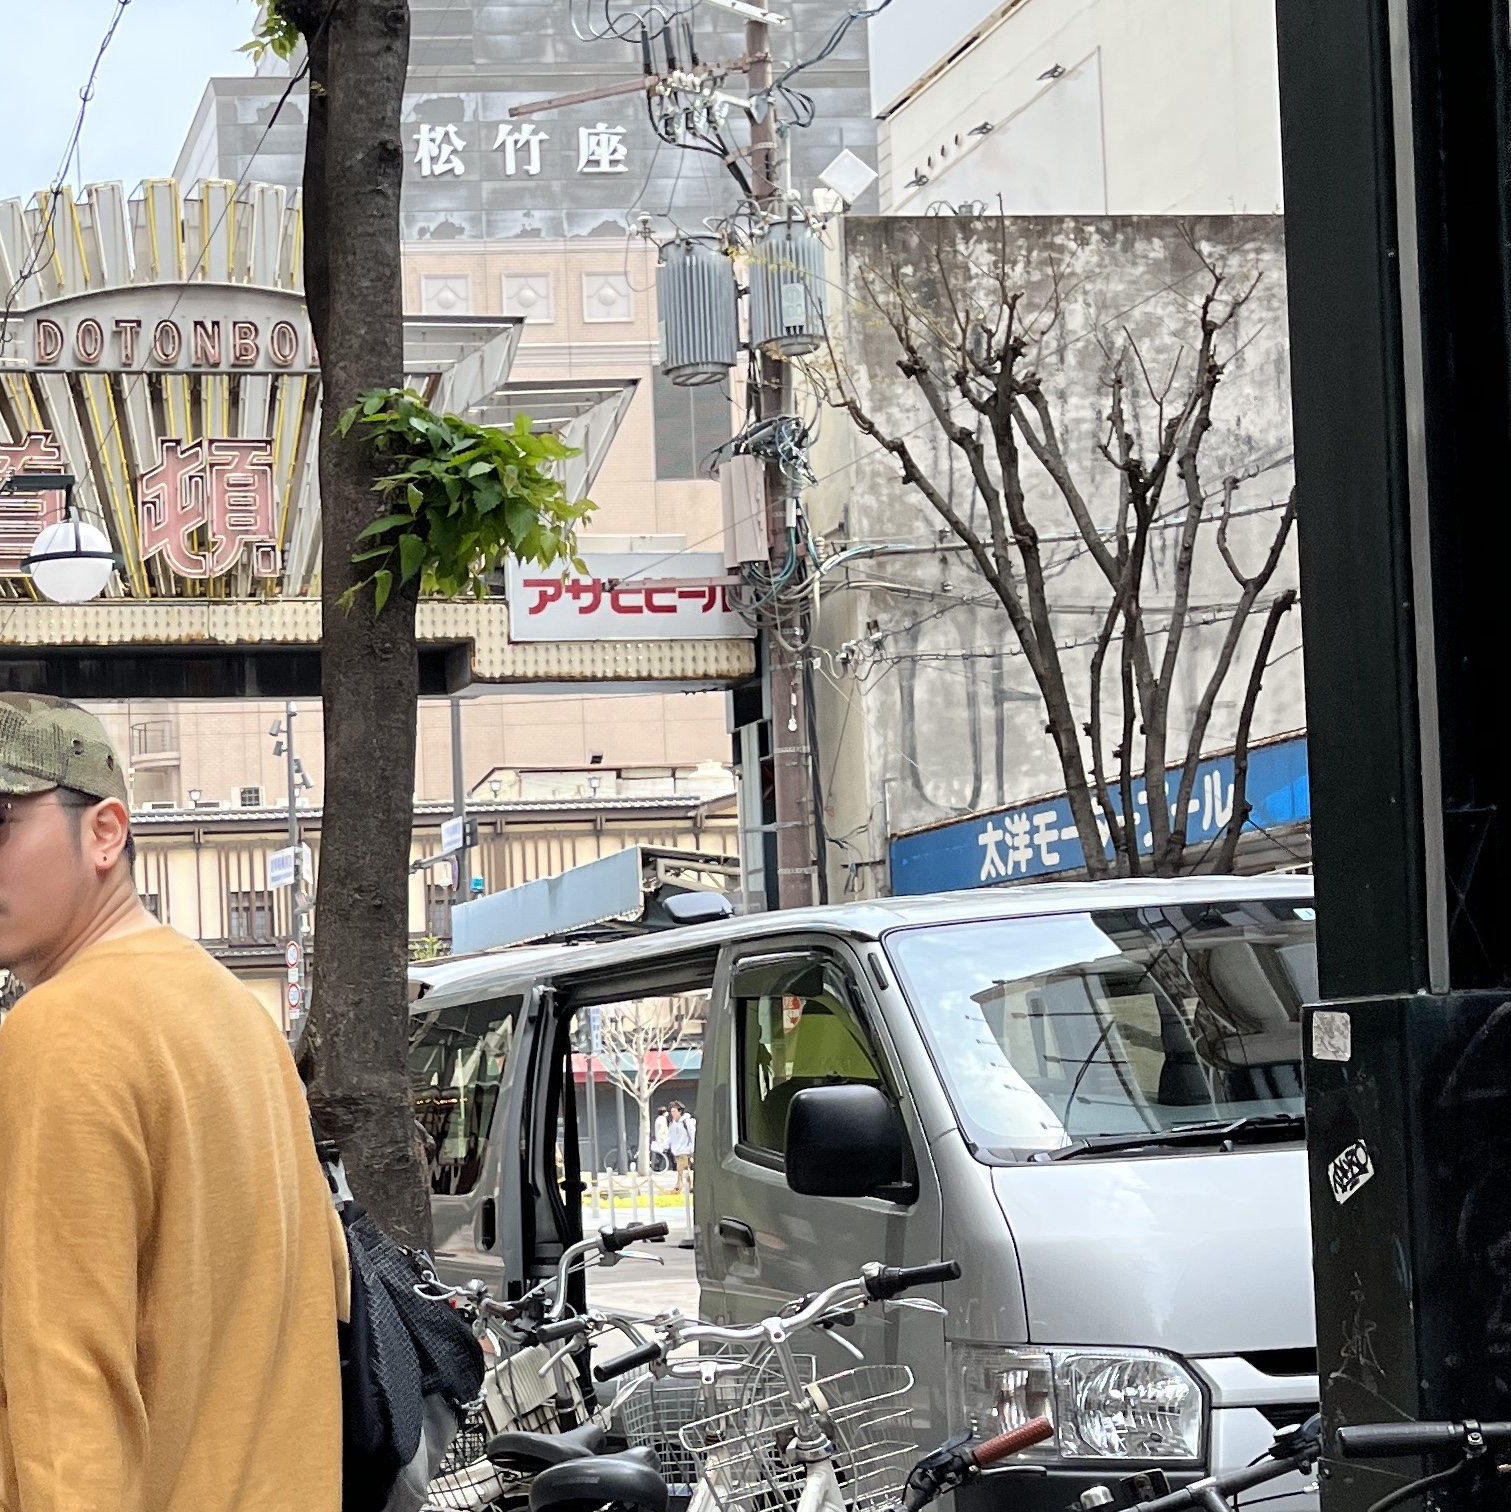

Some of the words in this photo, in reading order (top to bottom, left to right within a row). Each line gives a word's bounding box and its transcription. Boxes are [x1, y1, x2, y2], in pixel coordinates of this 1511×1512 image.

[412, 122, 629, 177] 松竹座
[34, 317, 321, 367] DOTONBO
